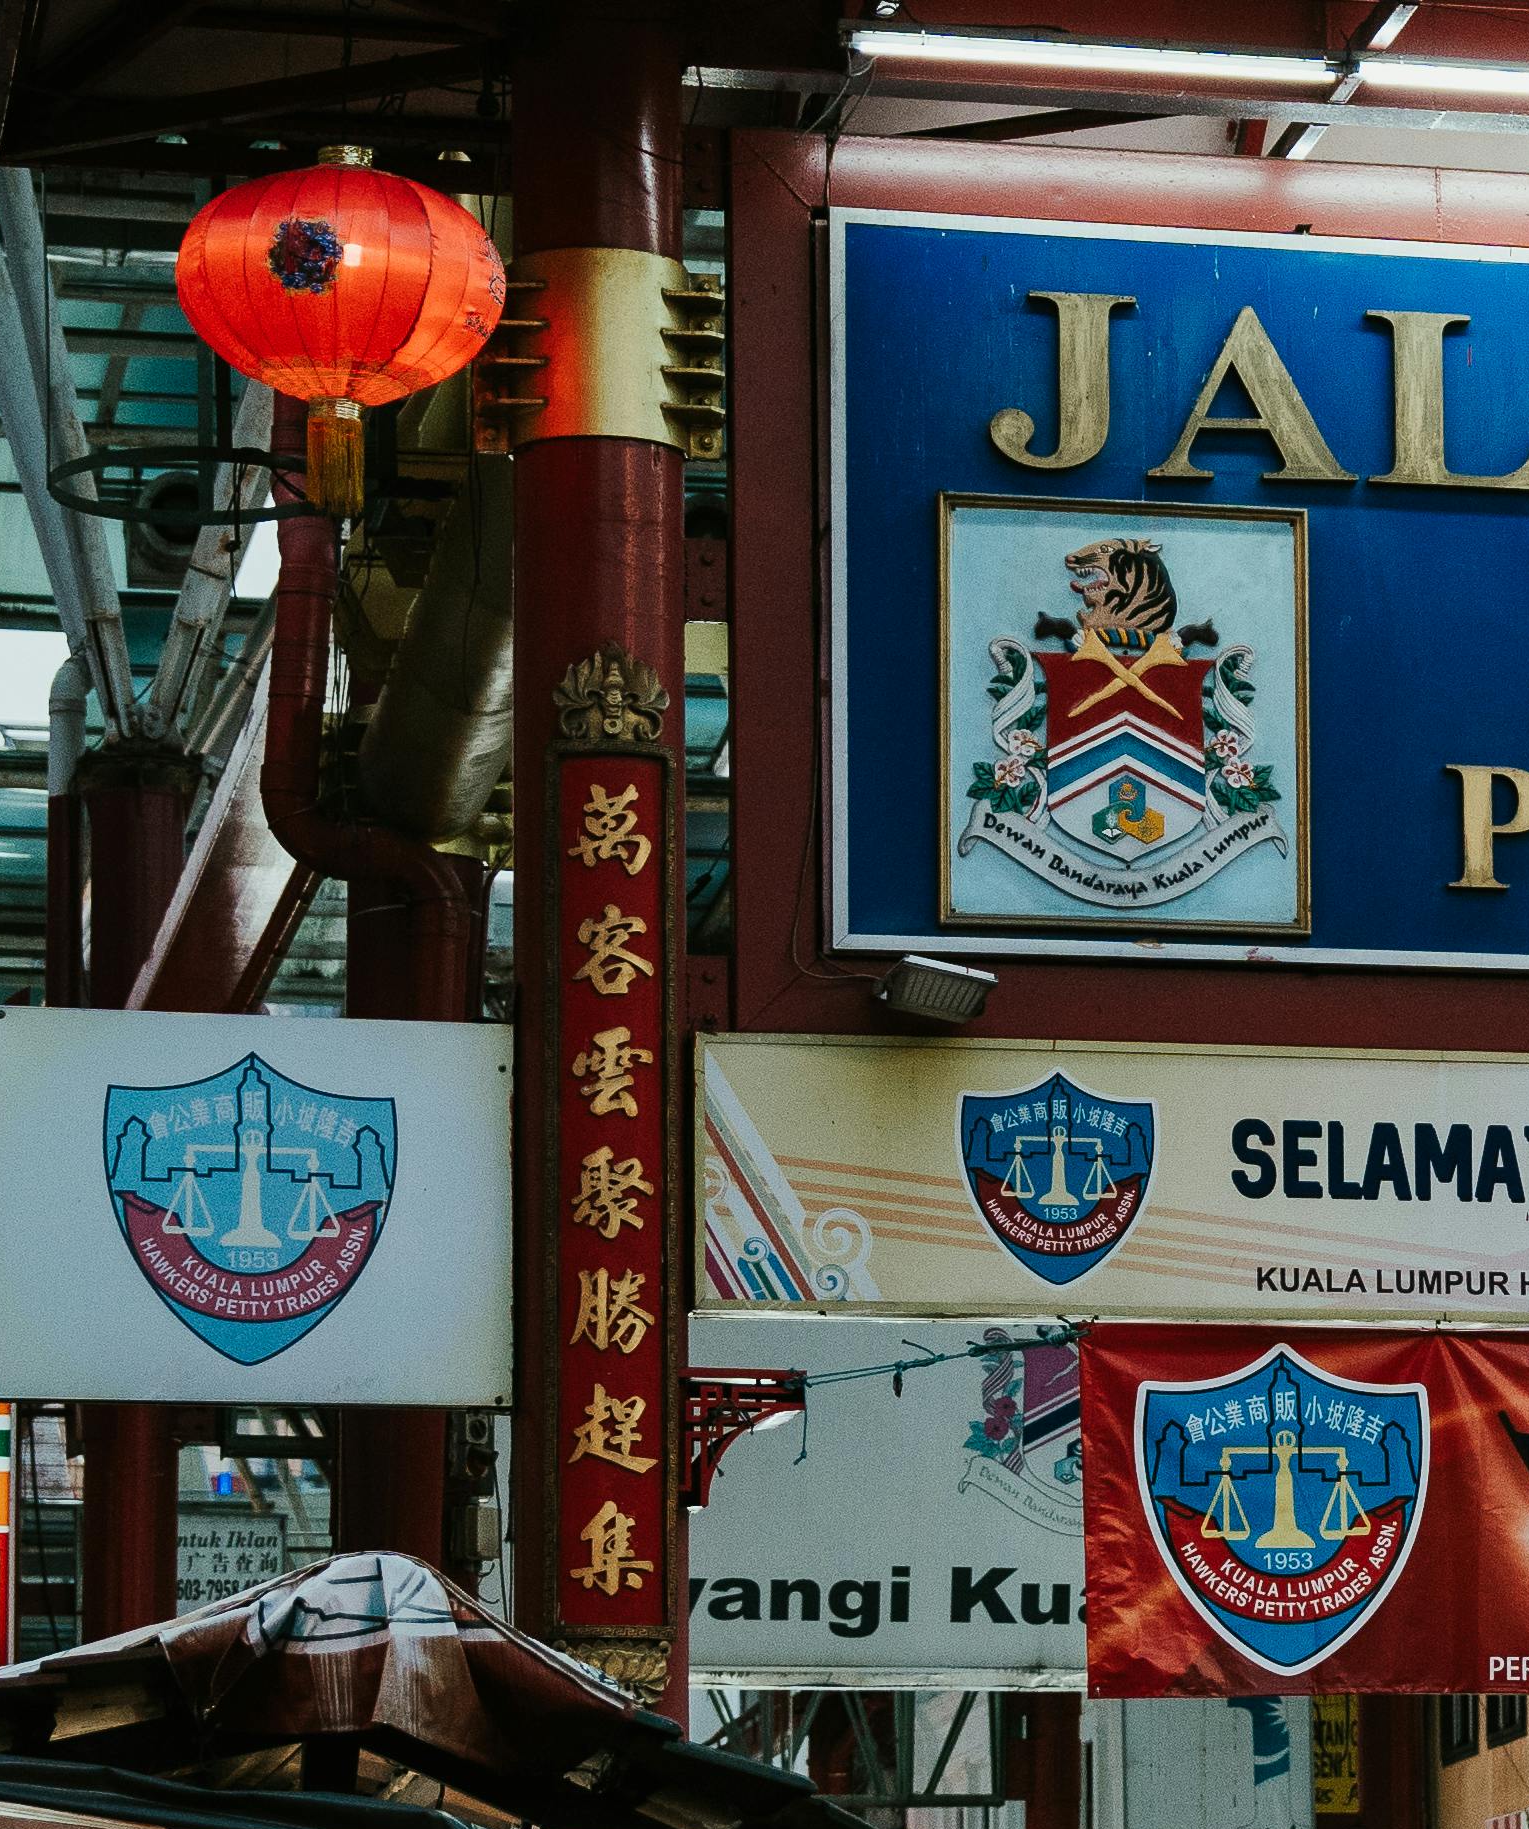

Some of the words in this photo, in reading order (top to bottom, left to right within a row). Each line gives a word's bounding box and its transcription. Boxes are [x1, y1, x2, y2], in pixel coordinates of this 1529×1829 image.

[983, 811, 1046, 860] Dewan
[1047, 853, 1149, 900] Bandaraya
[1153, 861, 1205, 890] Kuala
[1202, 813, 1270, 864] Lumpur
[1013, 1211, 1054, 1239] KUALA
[1058, 1212, 1109, 1240] LUMPUR
[1043, 1207, 1079, 1221] 1953
[227, 1250, 280, 1269] 1953
[1035, 1238, 1074, 1252] PETTY
[181, 1255, 243, 1297] KUALA
[250, 1258, 327, 1298] LUMPUR
[1257, 1267, 1368, 1295] KUALA
[1377, 1269, 1511, 1297] LUMPUR
[214, 1298, 271, 1317] PETTY
[1180, 1541, 1253, 1608] HAWKERS'
[1253, 1598, 1308, 1618] PETTY
[1309, 1567, 1373, 1616] TRADES'
[1367, 1519, 1399, 1571] ASSN.
[1263, 1552, 1314, 1571] 1953
[1219, 1557, 1280, 1598] KUALA
[1286, 1556, 1360, 1598] LUMPUR
